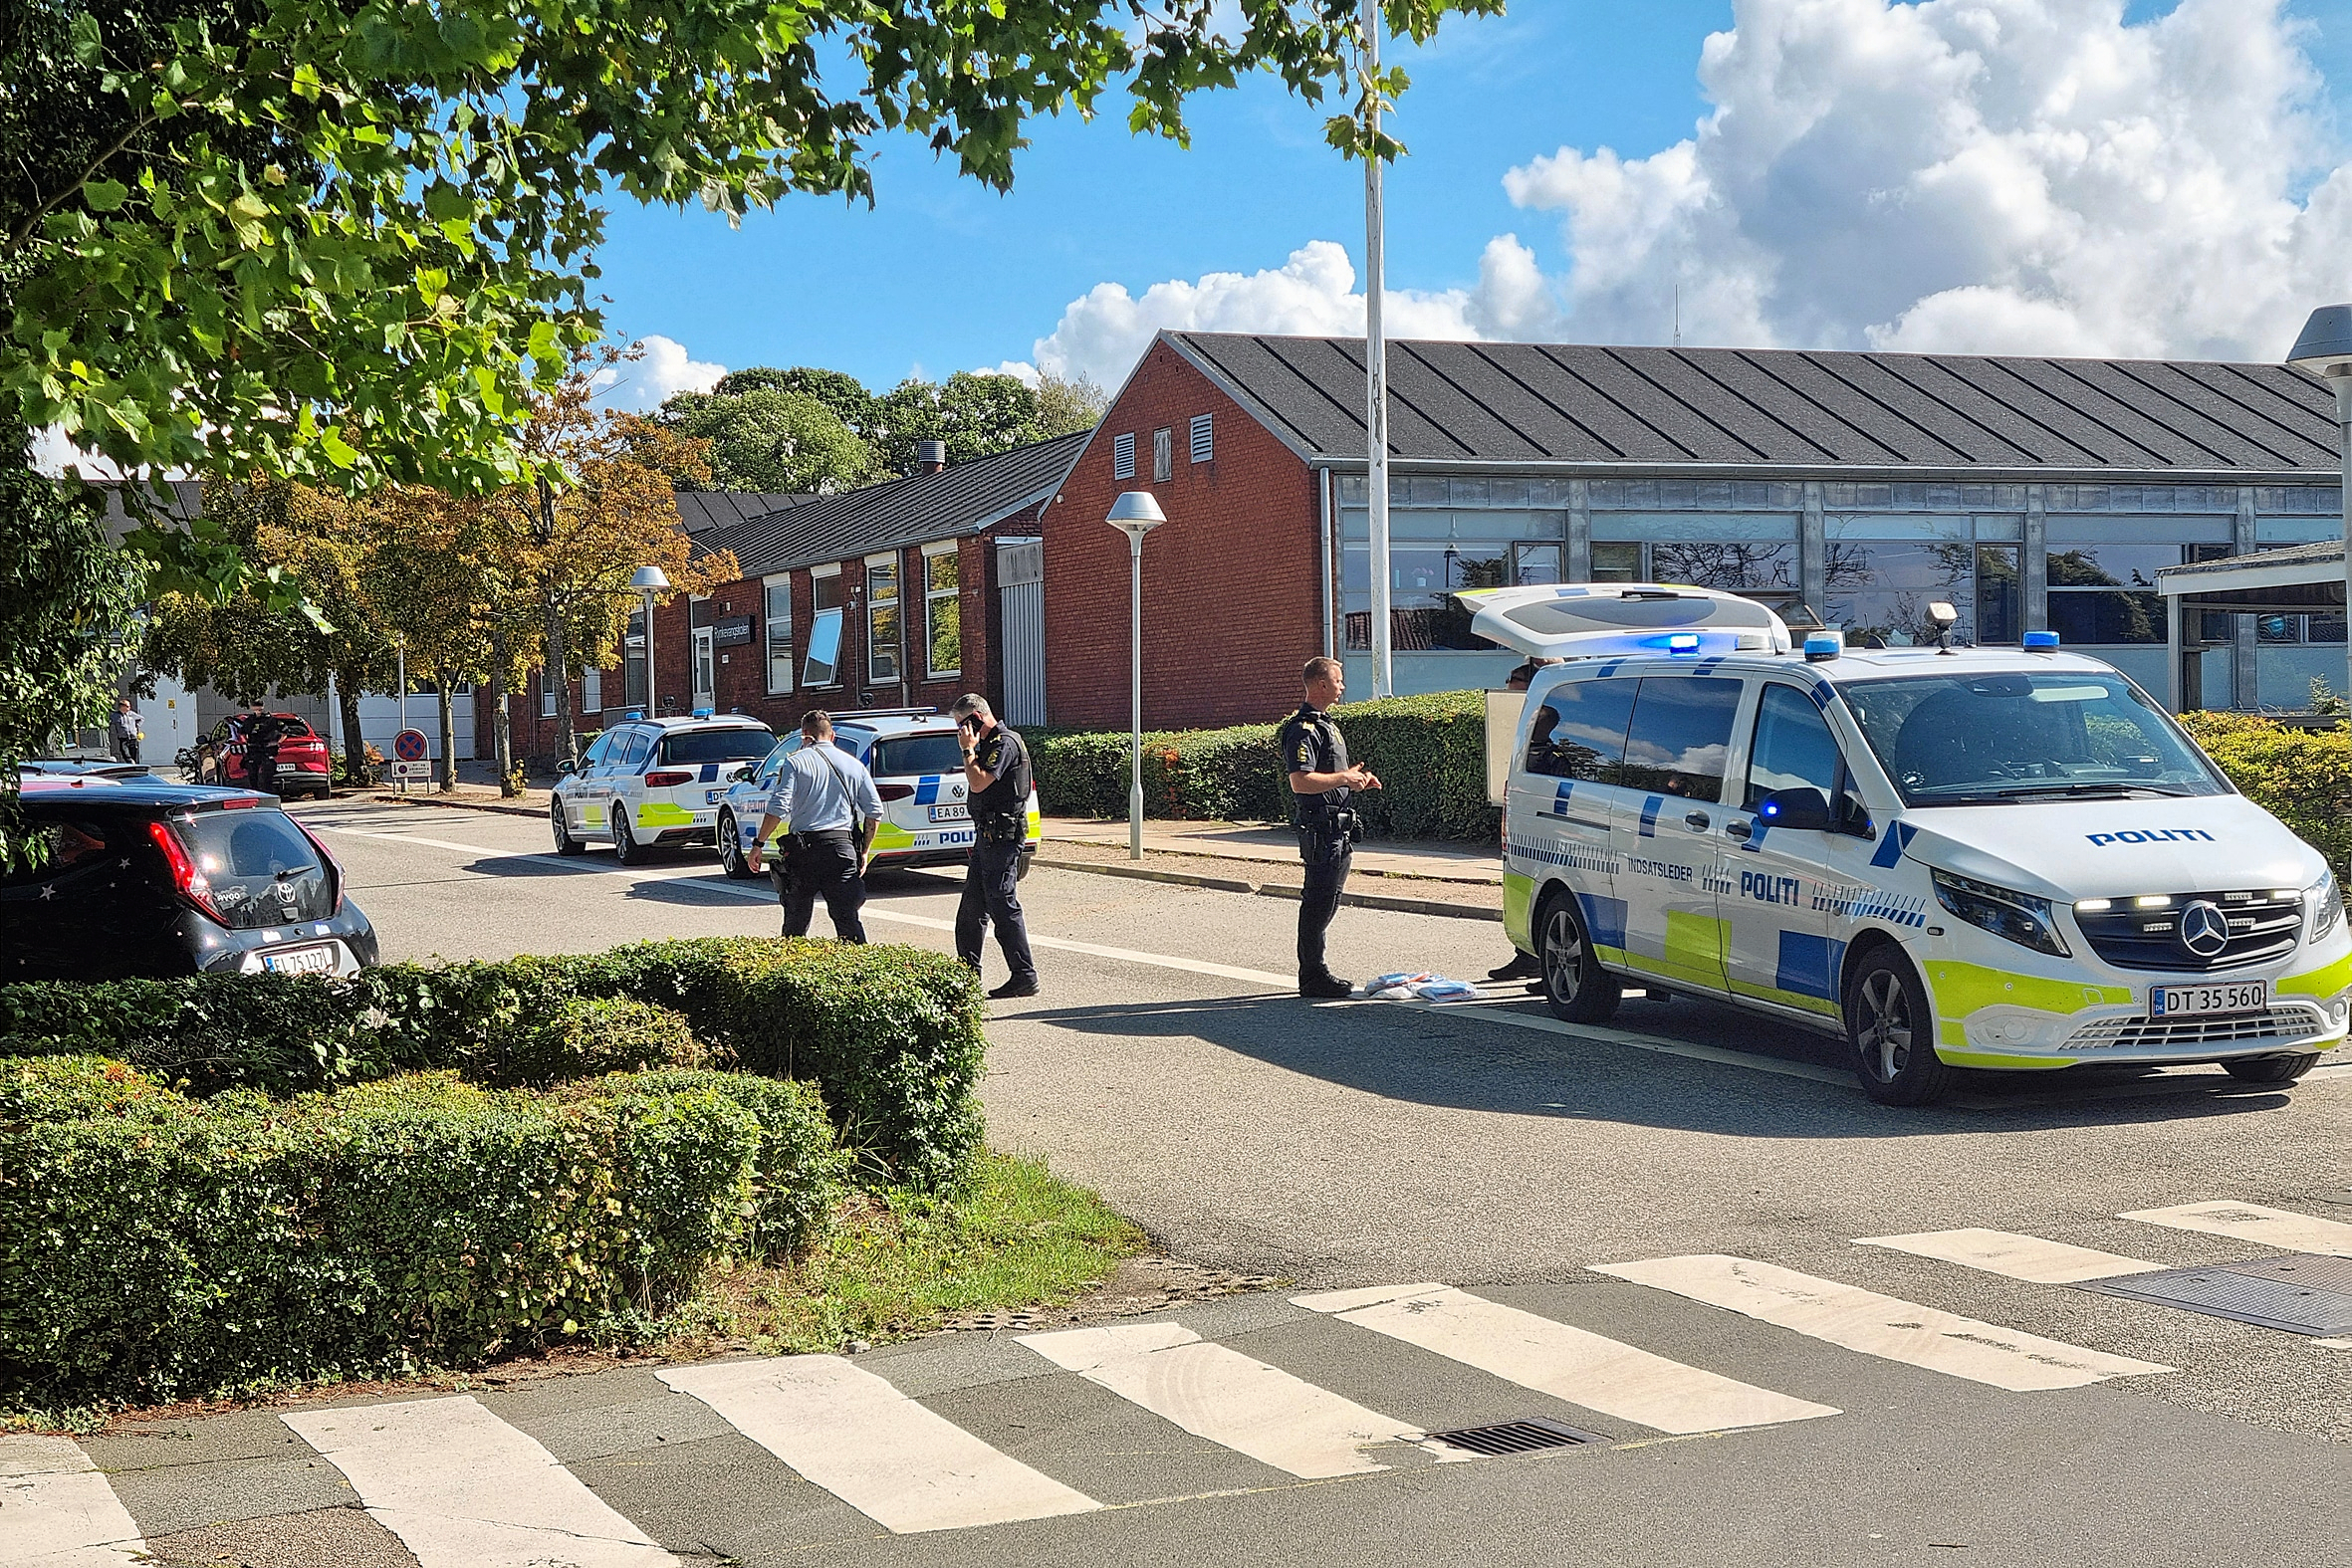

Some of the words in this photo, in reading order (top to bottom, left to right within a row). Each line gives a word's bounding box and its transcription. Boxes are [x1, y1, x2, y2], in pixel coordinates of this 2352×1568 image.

[937, 807, 951, 817] EA
[952, 806, 965, 816] 89
[939, 830, 977, 844] POLI
[2084, 829, 2216, 847] POLITI
[1627, 857, 1693, 883] INDSATSLEDER
[217, 892, 241, 902] AYGO
[1742, 870, 1800, 907] POLITI
[290, 955, 305, 972] 75
[306, 952, 323, 969] 127
[2167, 991, 2195, 1011] DT
[2200, 989, 2223, 1009] 35
[2228, 986, 2261, 1008] 560
